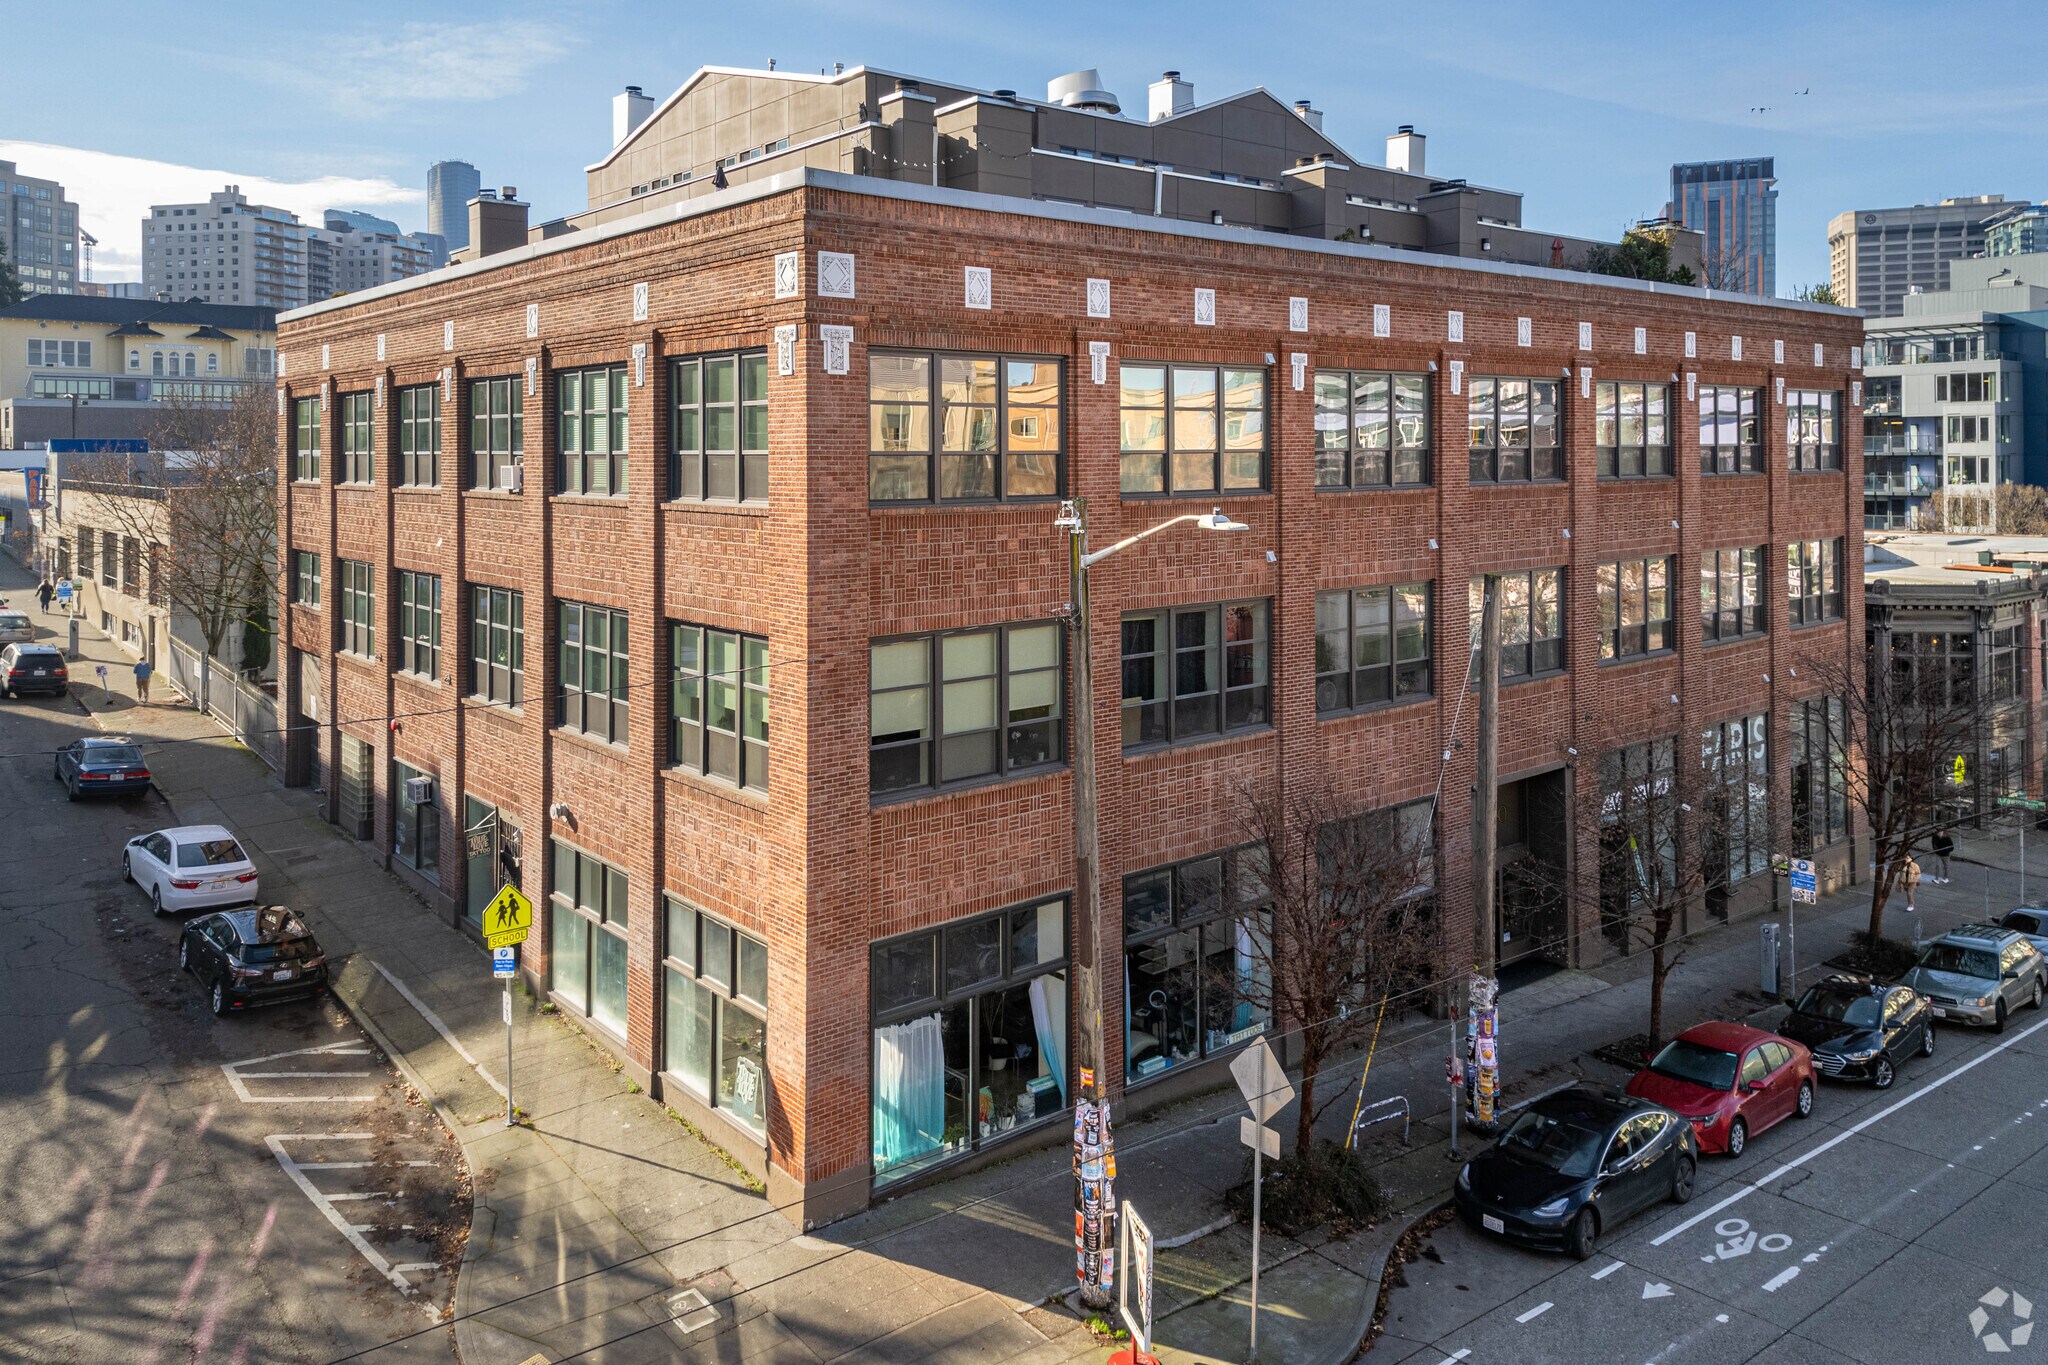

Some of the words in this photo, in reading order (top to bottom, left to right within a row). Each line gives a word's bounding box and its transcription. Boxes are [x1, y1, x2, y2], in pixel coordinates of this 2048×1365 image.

[468, 834, 489, 846] TRUE
[473, 841, 489, 851] LOVE
[468, 847, 491, 857] TATTOO
[492, 931, 526, 946] SCHOOL
[1231, 1024, 1263, 1043] TATTOOS
